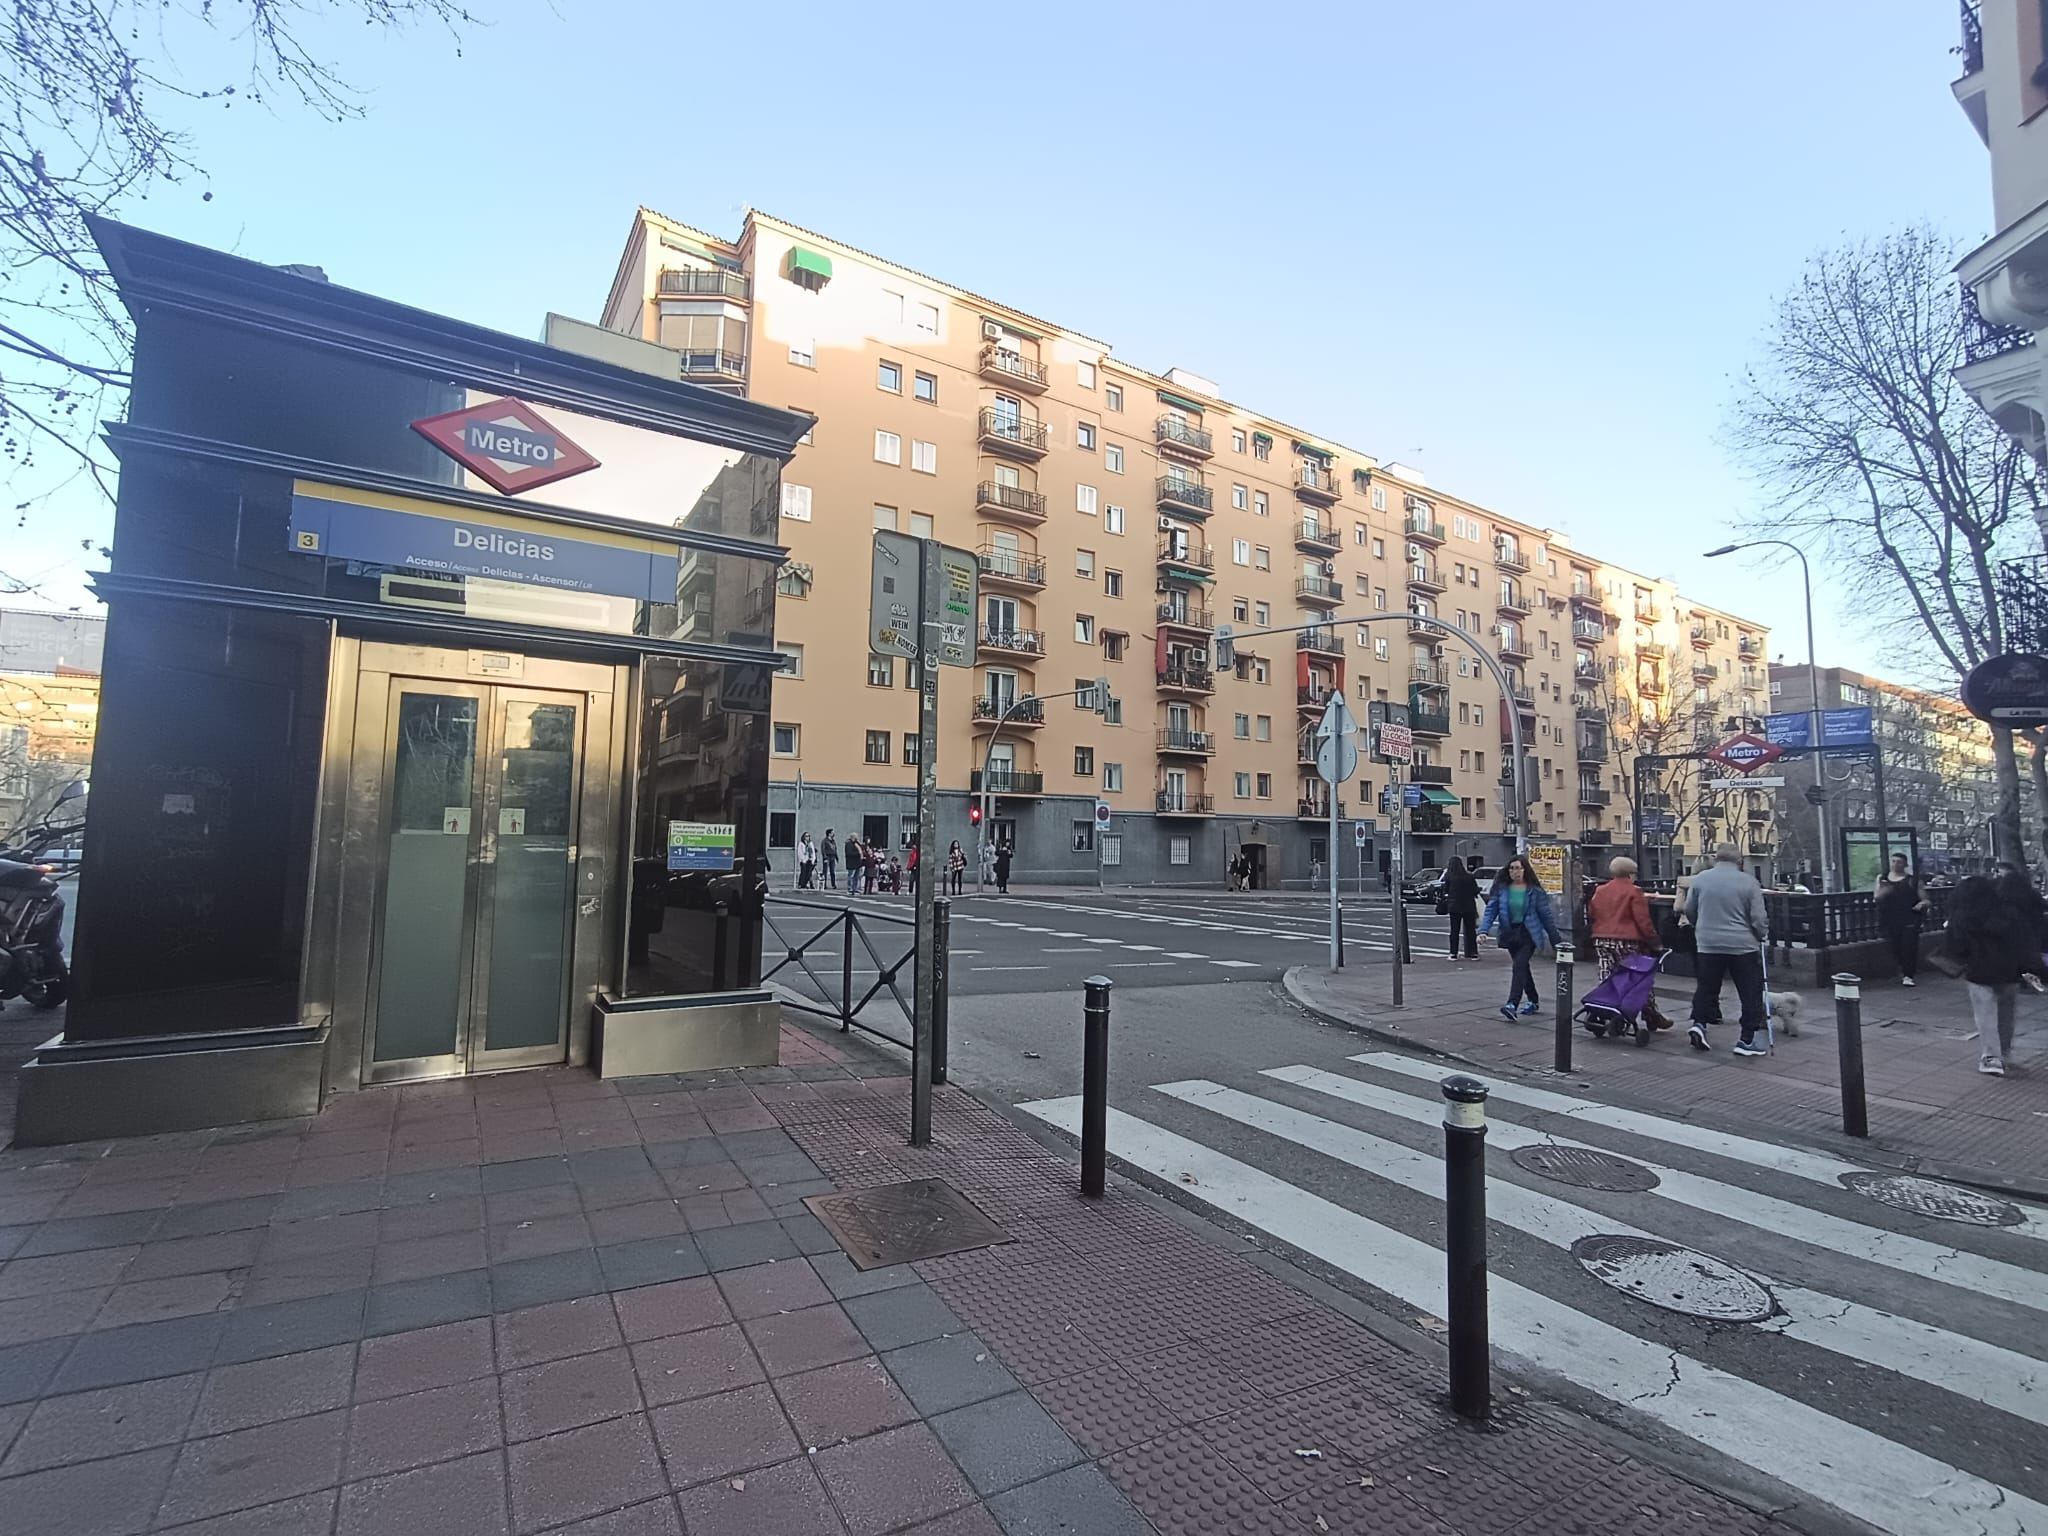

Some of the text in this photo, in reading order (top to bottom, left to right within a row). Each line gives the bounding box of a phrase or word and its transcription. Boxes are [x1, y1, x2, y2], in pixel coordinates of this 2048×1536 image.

[471, 427, 549, 461] Metro
[302, 534, 313, 547] 3
[453, 527, 555, 561] Delicias
[482, 566, 523, 579] Delicias
[591, 694, 595, 704] 1
[1383, 724, 1409, 736] COMPRO
[1390, 732, 1410, 743] COCHE
[1727, 749, 1761, 758] Metro
[674, 848, 682, 856] -1
